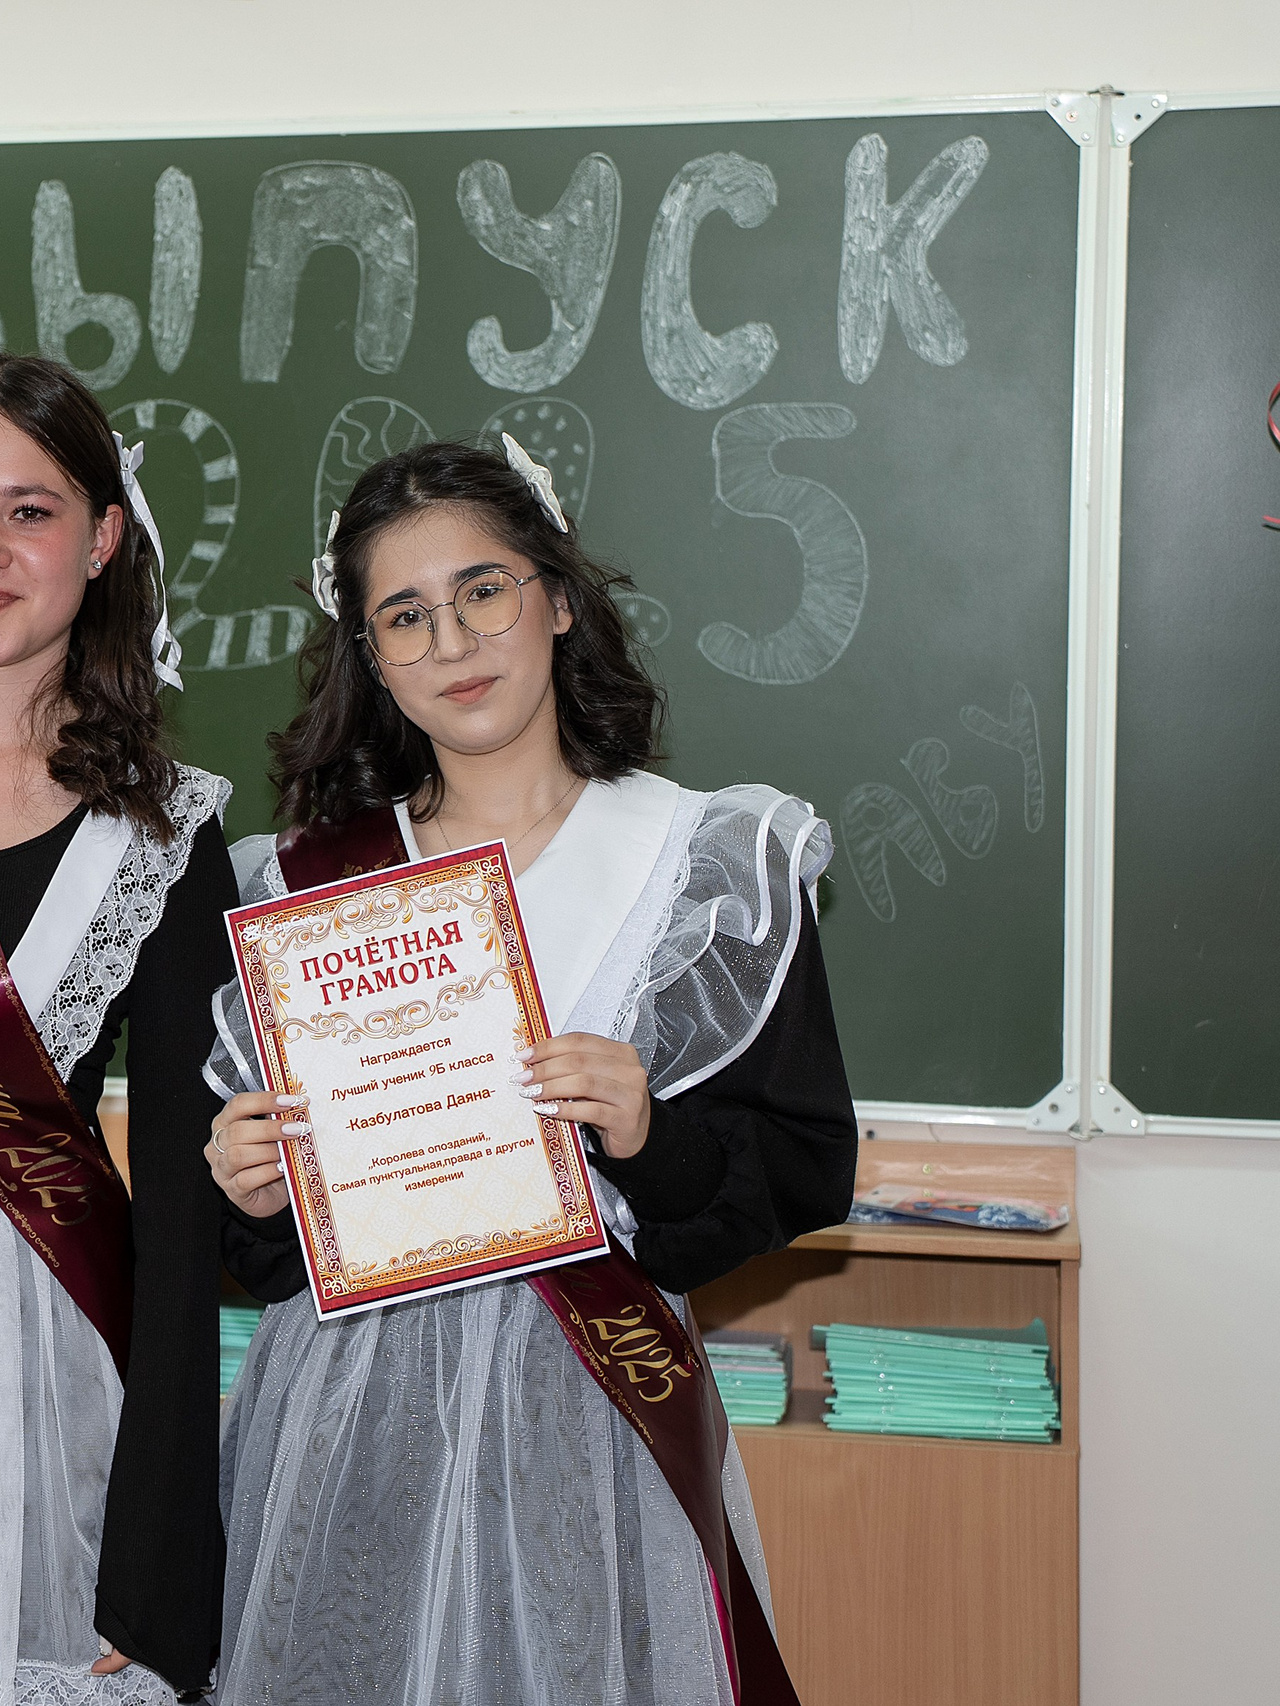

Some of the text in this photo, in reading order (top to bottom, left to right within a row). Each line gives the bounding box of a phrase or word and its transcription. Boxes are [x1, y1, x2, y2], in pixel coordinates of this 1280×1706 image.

[299, 920, 464, 983] ПОЧЁТНАЯ
[319, 953, 458, 1006] ГРАМОТА
[330, 1053, 495, 1102] Лучший ученик 9Б класса
[359, 1037, 452, 1068] Награждается
[345, 1088, 497, 1131] -Казбулатова Даяна-
[331, 1177, 367, 1194] Самая
[485, 1148, 493, 1157] в
[495, 1137, 536, 1155] другом
[404, 1170, 465, 1192] измерении
[586, 1303, 693, 1403] 2025
